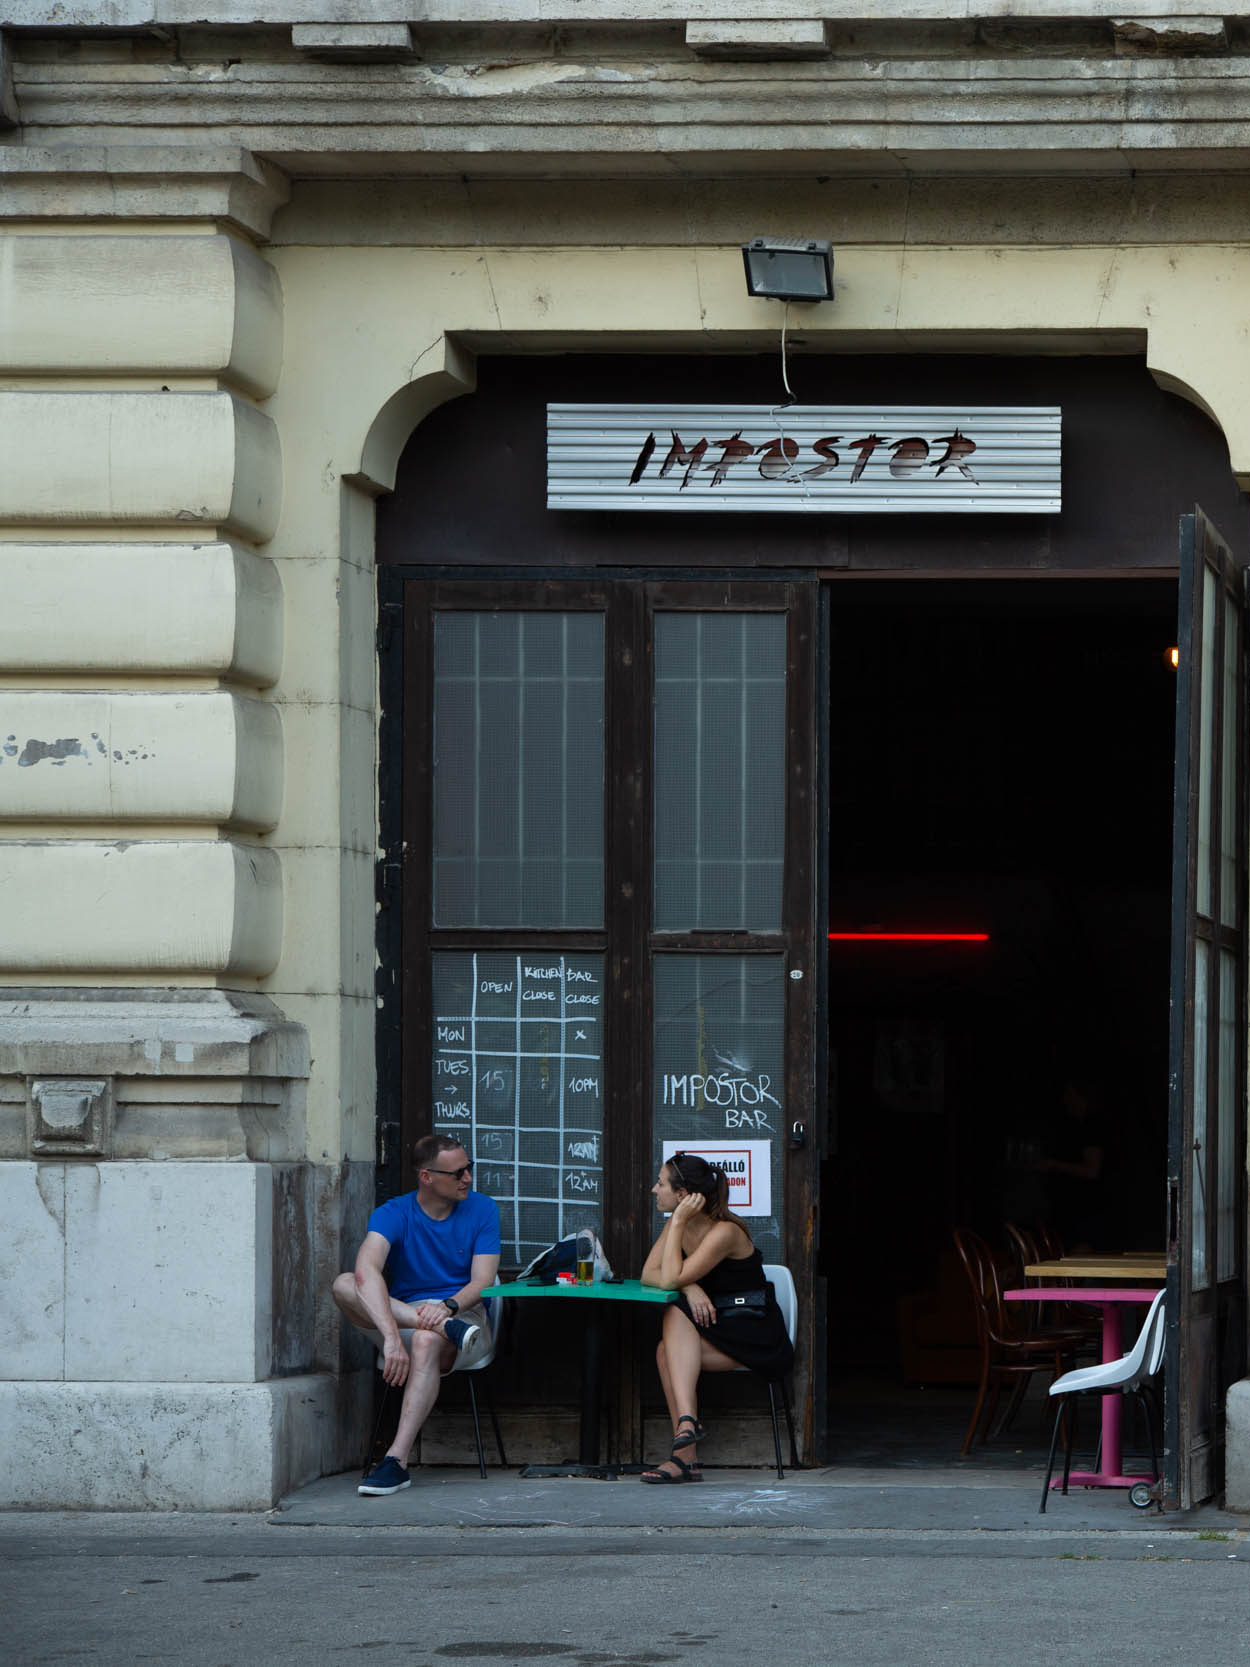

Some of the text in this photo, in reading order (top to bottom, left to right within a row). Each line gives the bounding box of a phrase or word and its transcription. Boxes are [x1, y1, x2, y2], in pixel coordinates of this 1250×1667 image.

[629, 427, 979, 492] IMPOSTOR
[525, 967, 562, 979] KITCHEN
[566, 968, 599, 982] BAR
[480, 981, 513, 993] OPEN
[522, 991, 557, 1001] CLOSE
[565, 994, 600, 1005] CLOSE
[437, 1026, 465, 1043] MON
[568, 1077, 599, 1098] 10PM
[663, 1072, 782, 1109] IMPOSTOR
[725, 1109, 777, 1133] BAR
